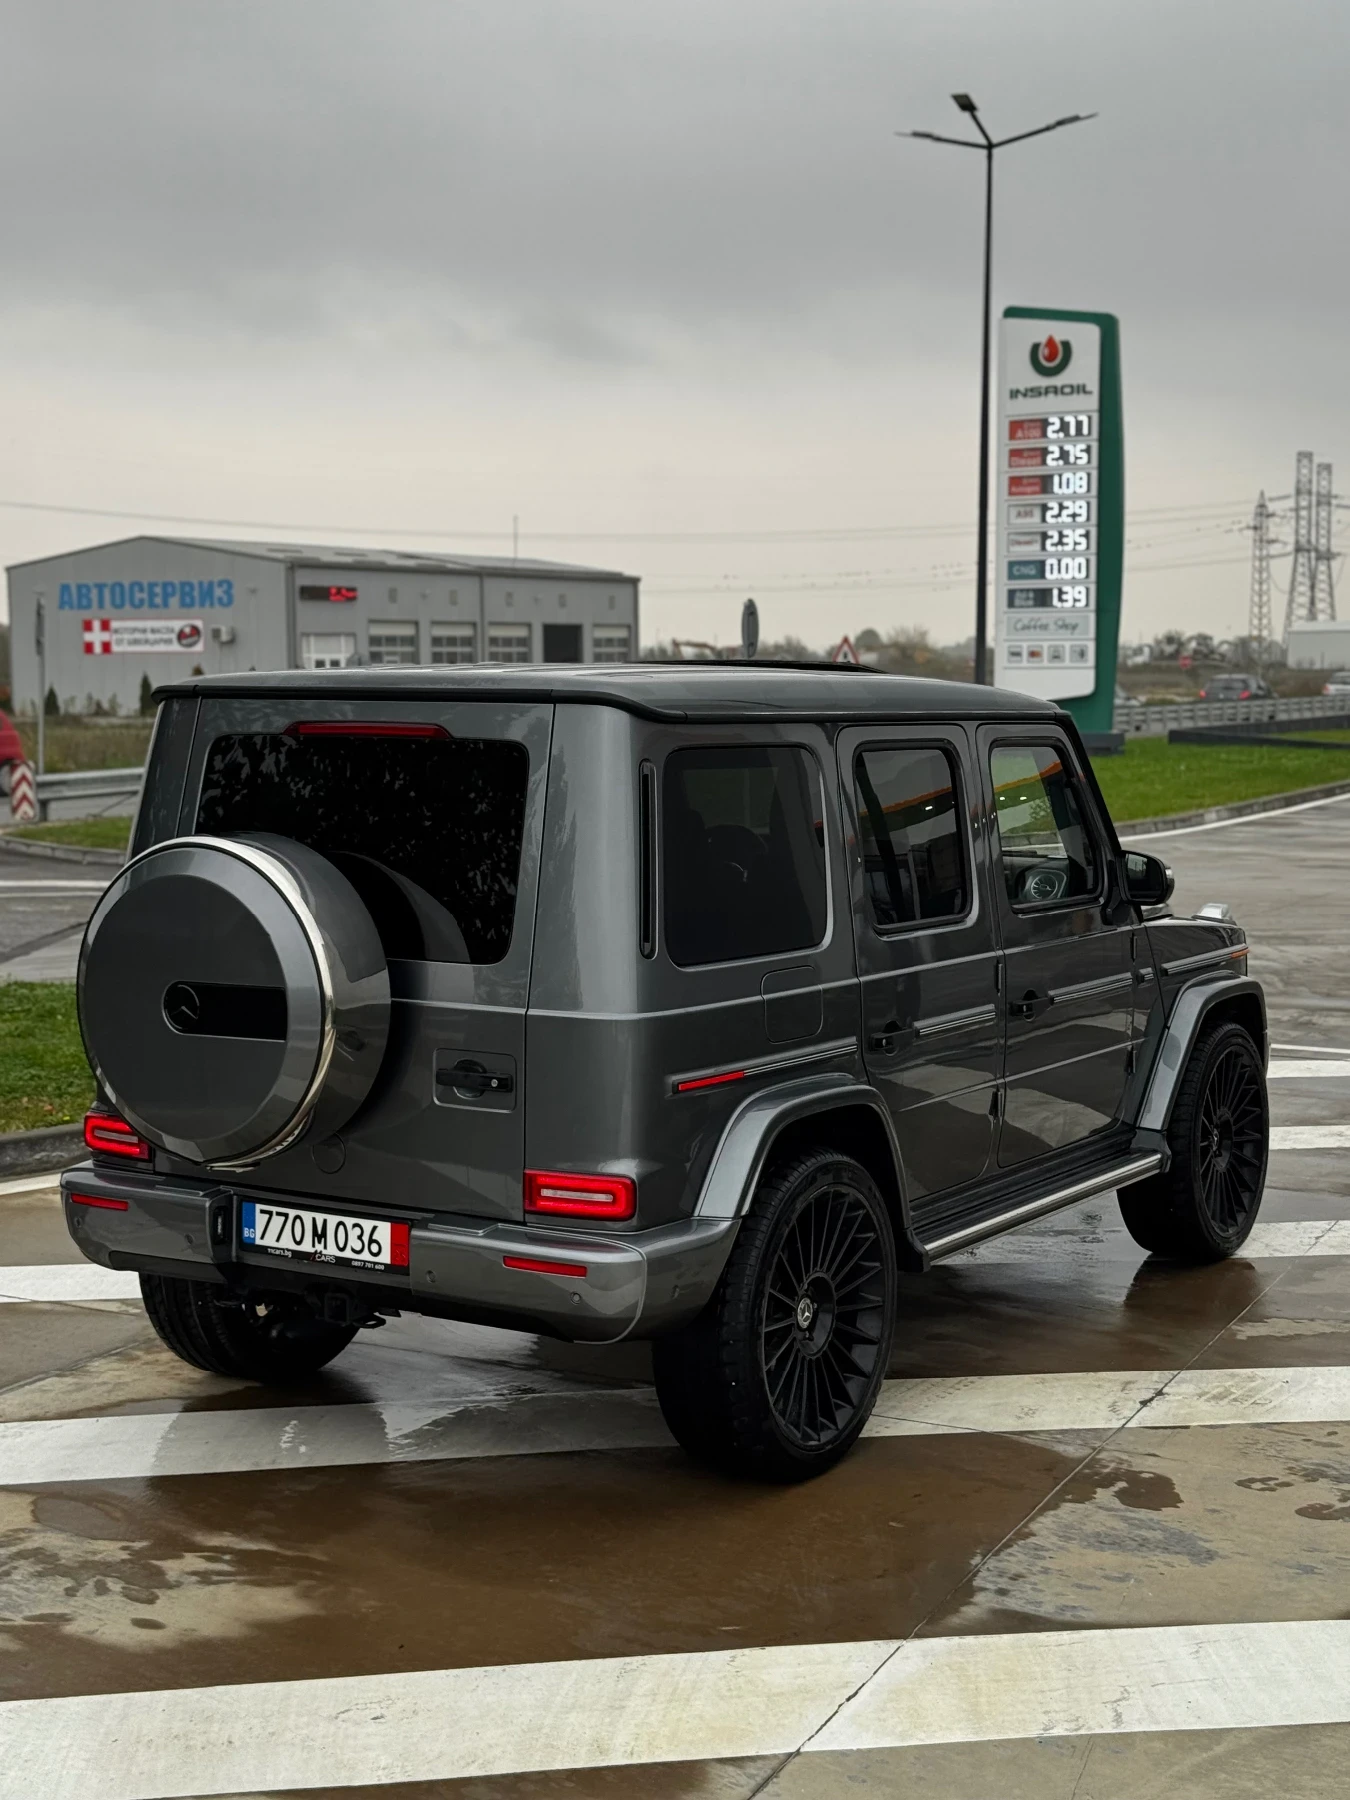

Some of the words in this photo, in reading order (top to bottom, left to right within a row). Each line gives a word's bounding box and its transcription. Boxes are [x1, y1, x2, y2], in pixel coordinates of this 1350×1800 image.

[1010, 384, 1093, 400] INSAOIL
[1046, 415, 1089, 439] 2.77
[1046, 444, 1089, 467] 2.75
[1053, 472, 1088, 495] 1.08
[1045, 500, 1088, 524] 2.29
[1045, 528, 1088, 552] 2.35
[1012, 565, 1037, 576] CNG
[1045, 557, 1087, 580] 0.00
[58, 579, 234, 610] АВТОСЕРВИЗ
[1052, 585, 1087, 608] 1.39
[1013, 618, 1049, 632] Coffee
[1053, 617, 1079, 636] Shop
[244, 1227, 255, 1239] BG
[260, 1208, 305, 1246] 770
[334, 1220, 382, 1257] 036
[315, 1253, 336, 1263] CARS
